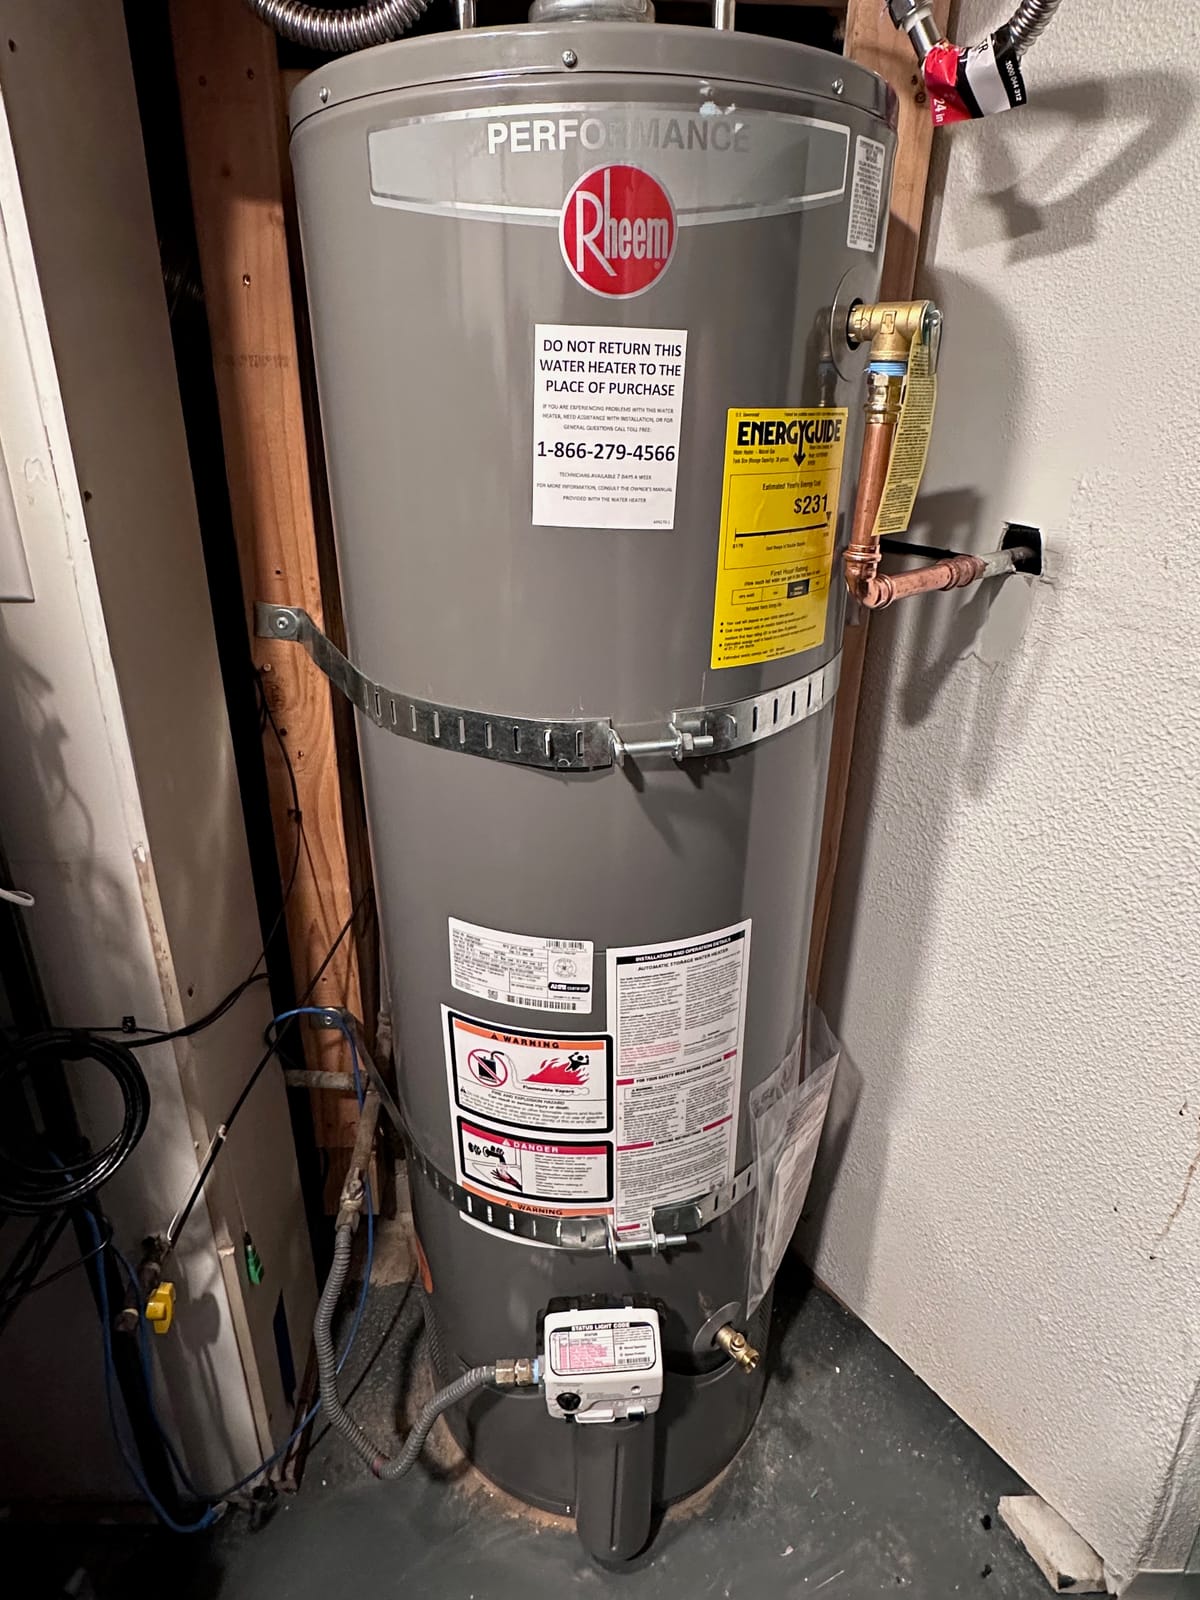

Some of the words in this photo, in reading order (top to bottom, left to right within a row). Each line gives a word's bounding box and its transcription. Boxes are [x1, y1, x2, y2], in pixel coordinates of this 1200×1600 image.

[933, 98, 947, 112] 24
[935, 113, 943, 122] in
[487, 118, 750, 154] PERFORMANCE
[576, 168, 668, 277] Rheem
[543, 339, 562, 352] DO
[567, 340, 595, 353] NOT
[599, 342, 650, 356] RETURN
[655, 344, 682, 357] THIS
[540, 359, 585, 373] WATER
[588, 361, 636, 374] HEATER
[639, 363, 656, 375] TO
[659, 364, 681, 376] THE
[546, 380, 584, 393] PLACE
[588, 381, 606, 393] OF
[609, 382, 675, 396] PURCHASE
[737, 419, 842, 446] ENERGYGUIDE
[537, 441, 675, 461] 1-866-279-4566
[794, 493, 828, 514] $231
[635, 953, 672, 962] INSTALLATION
[685, 943, 712, 954] OPERATION
[638, 963, 669, 971] AUTOMATIC
[670, 958, 693, 966] STORAGE
[711, 948, 728, 957] HEATER
[504, 1035, 560, 1049] WARNING
[523, 1084, 553, 1093] Flammable
[513, 1141, 559, 1153] DANGER
[518, 1204, 563, 1216] WARNING
